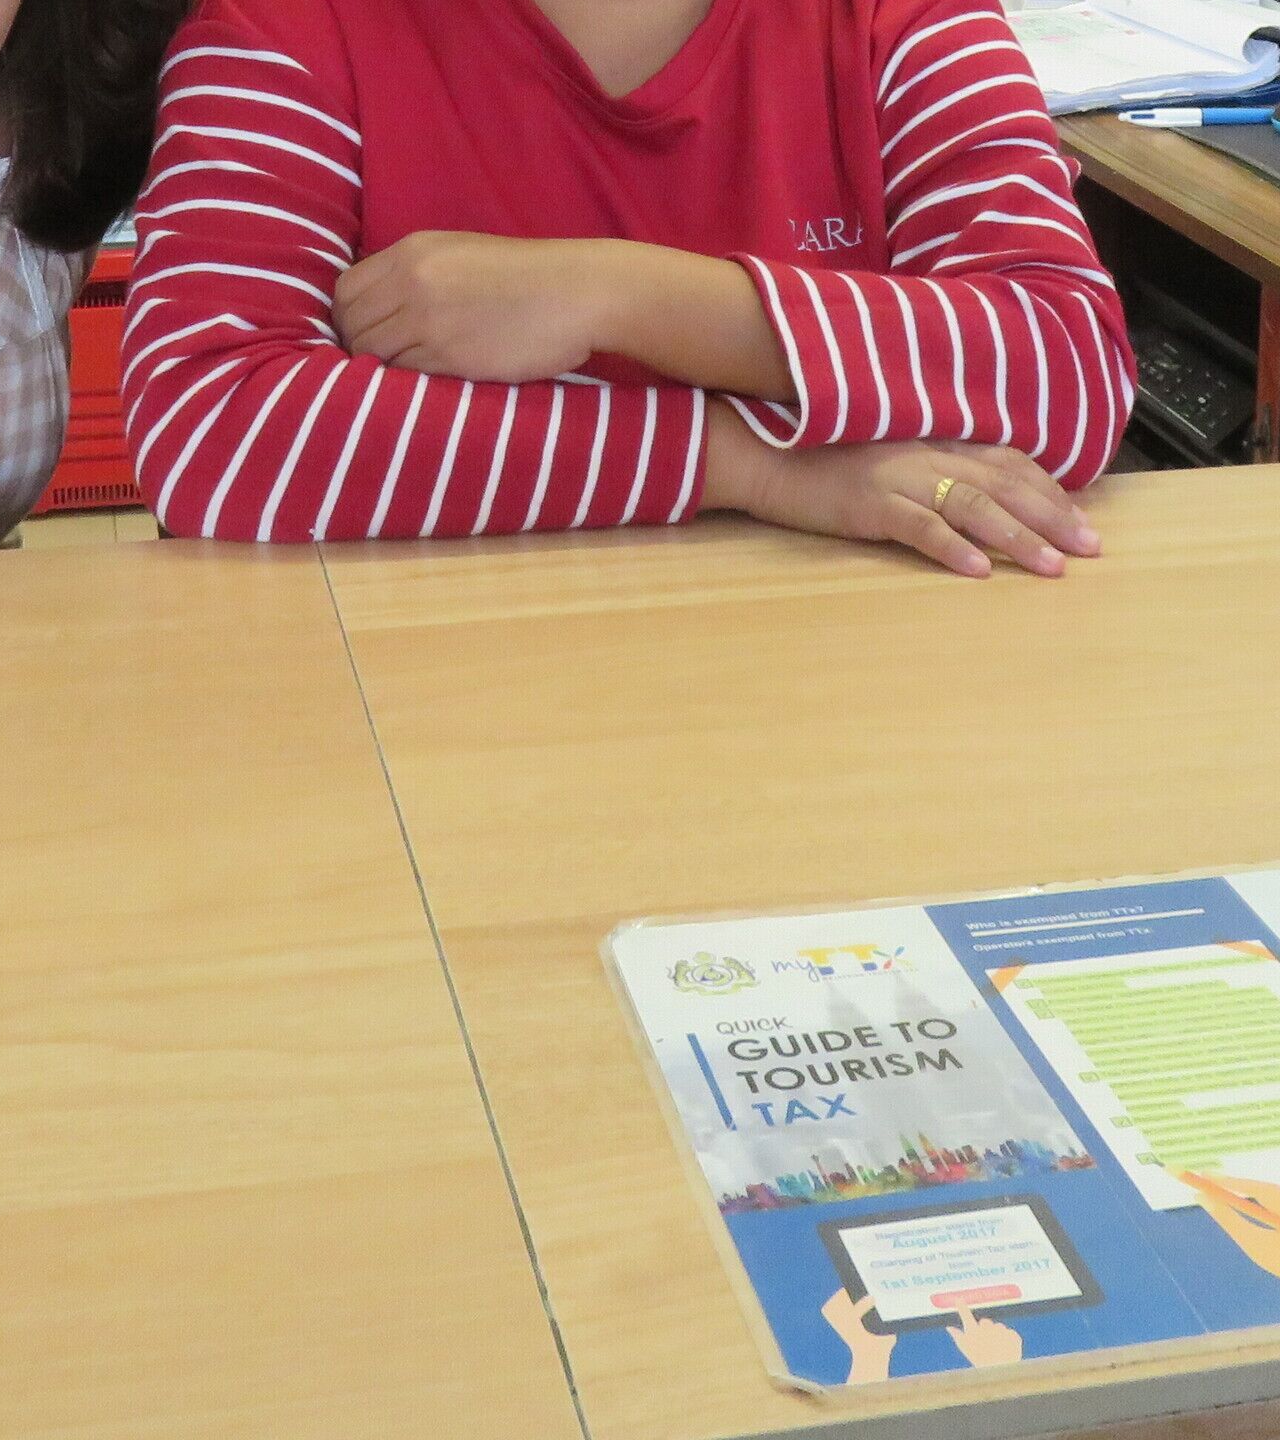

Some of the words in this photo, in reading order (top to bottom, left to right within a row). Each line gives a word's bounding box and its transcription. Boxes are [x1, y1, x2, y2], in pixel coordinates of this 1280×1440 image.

[966, 921, 996, 930] Who
[1014, 912, 1078, 927] exempted
[1078, 908, 1111, 919] from
[1035, 932, 1095, 945] exempted
[1097, 929, 1126, 939] from
[716, 1016, 793, 1037] QUICK
[727, 1025, 882, 1061] GUIDE
[890, 1017, 958, 1044] TO
[735, 1047, 964, 1095] TOURISM
[751, 1092, 858, 1128] TAX
[892, 1232, 952, 1250] August
[959, 1225, 998, 1241] 2017
[911, 1266, 1006, 1286] September
[1013, 1257, 1051, 1273] 2017
